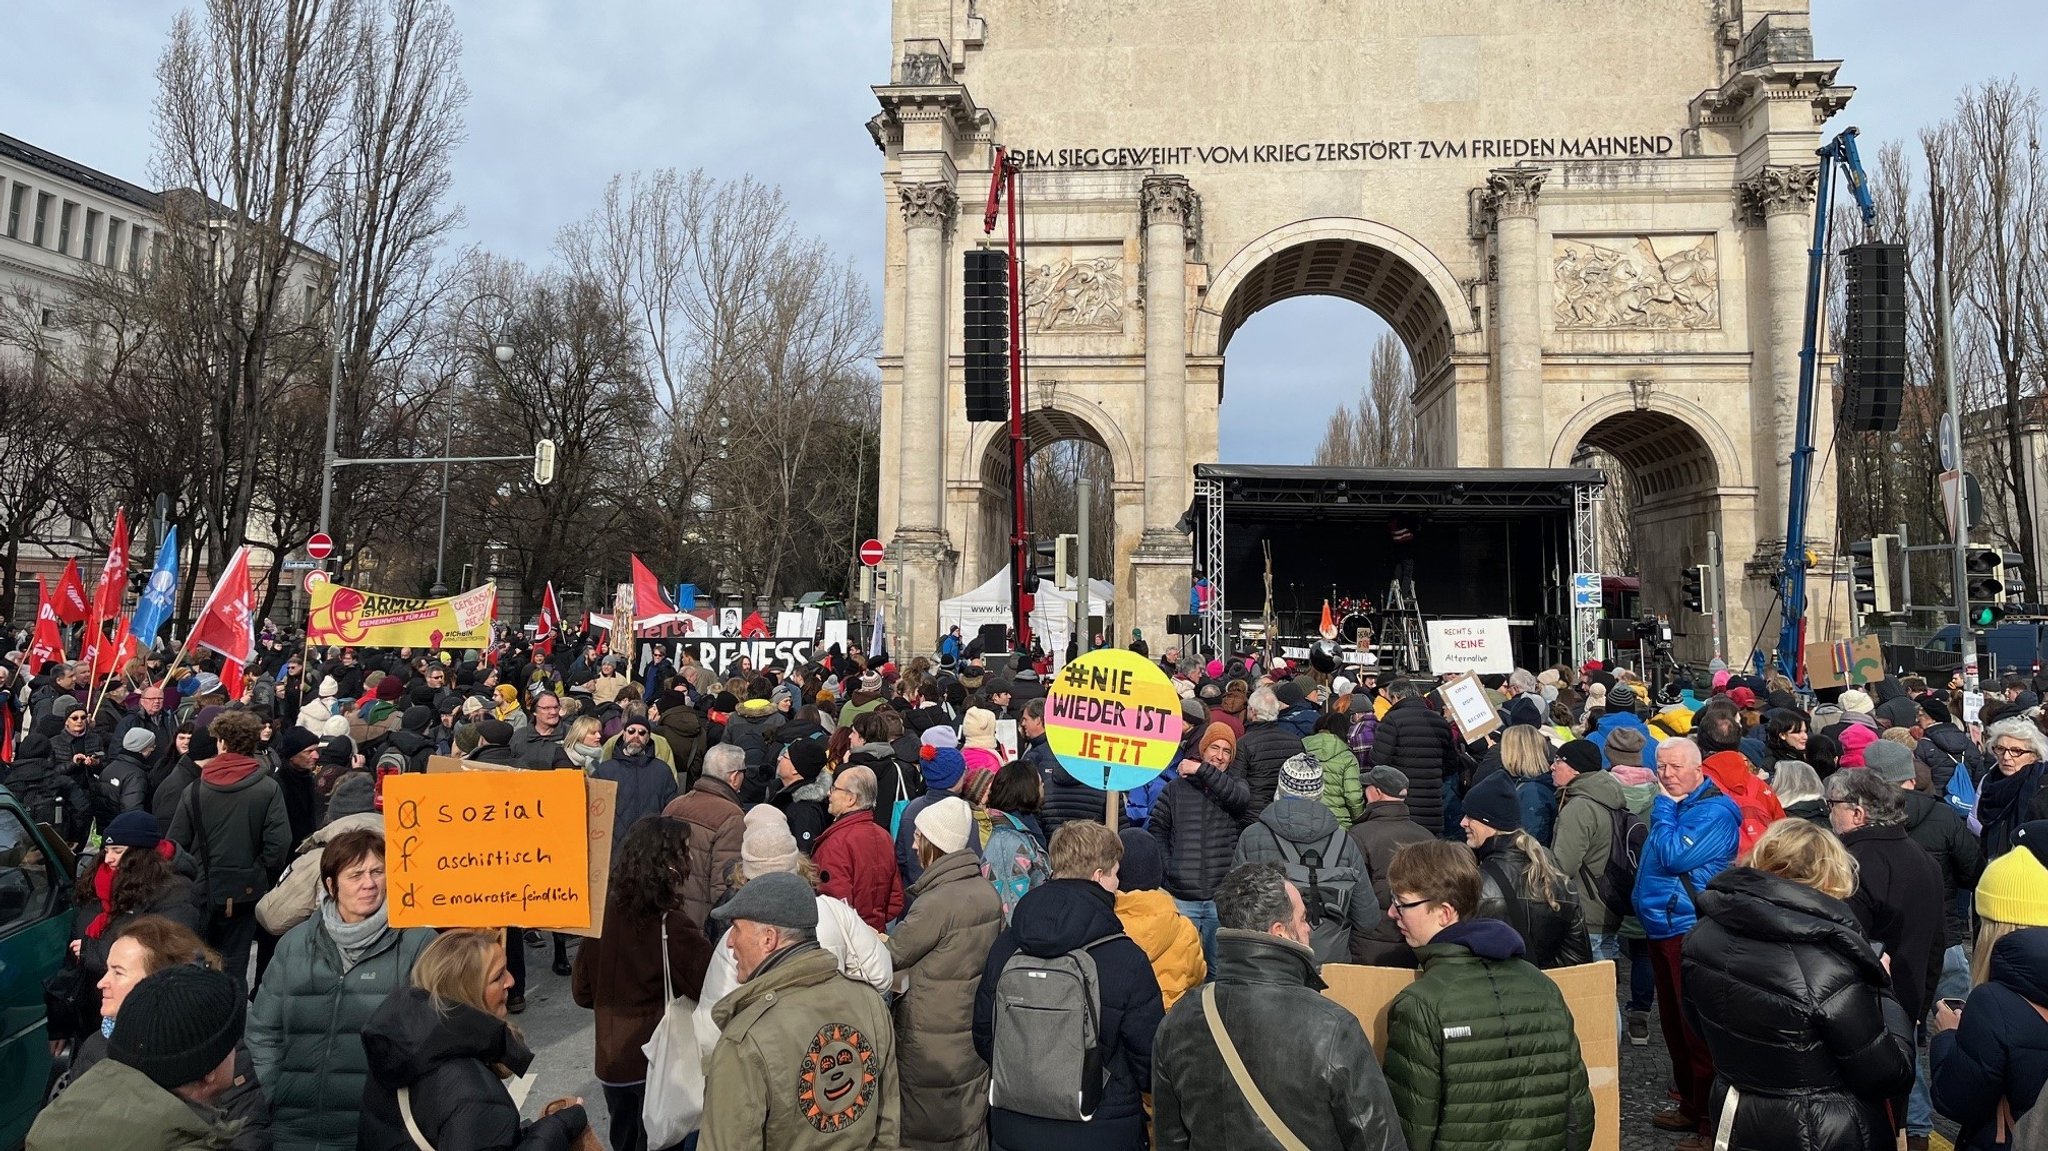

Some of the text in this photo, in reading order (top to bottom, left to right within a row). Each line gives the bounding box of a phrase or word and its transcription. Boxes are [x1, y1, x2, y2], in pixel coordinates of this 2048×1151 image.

[1011, 136, 1673, 167] DEM SIEG GEWEIHT VOM KRIEG ZERSTÖRT ZVM FRIEDEN MAHNEND
[971, 604, 1011, 615] www.kjr-
[359, 616, 405, 627] GEMEINWOHL
[637, 616, 694, 638] lerta
[1444, 628, 1472, 636] RECHTS
[1454, 639, 1486, 649] KEINE
[638, 640, 811, 677] ARENESS
[1064, 662, 1133, 695] #NIE
[1052, 692, 1172, 733] WIEDER IST
[1078, 732, 1147, 766] JETZT
[437, 800, 545, 823] sozial
[1443, 1025, 1472, 1039] PUMA
